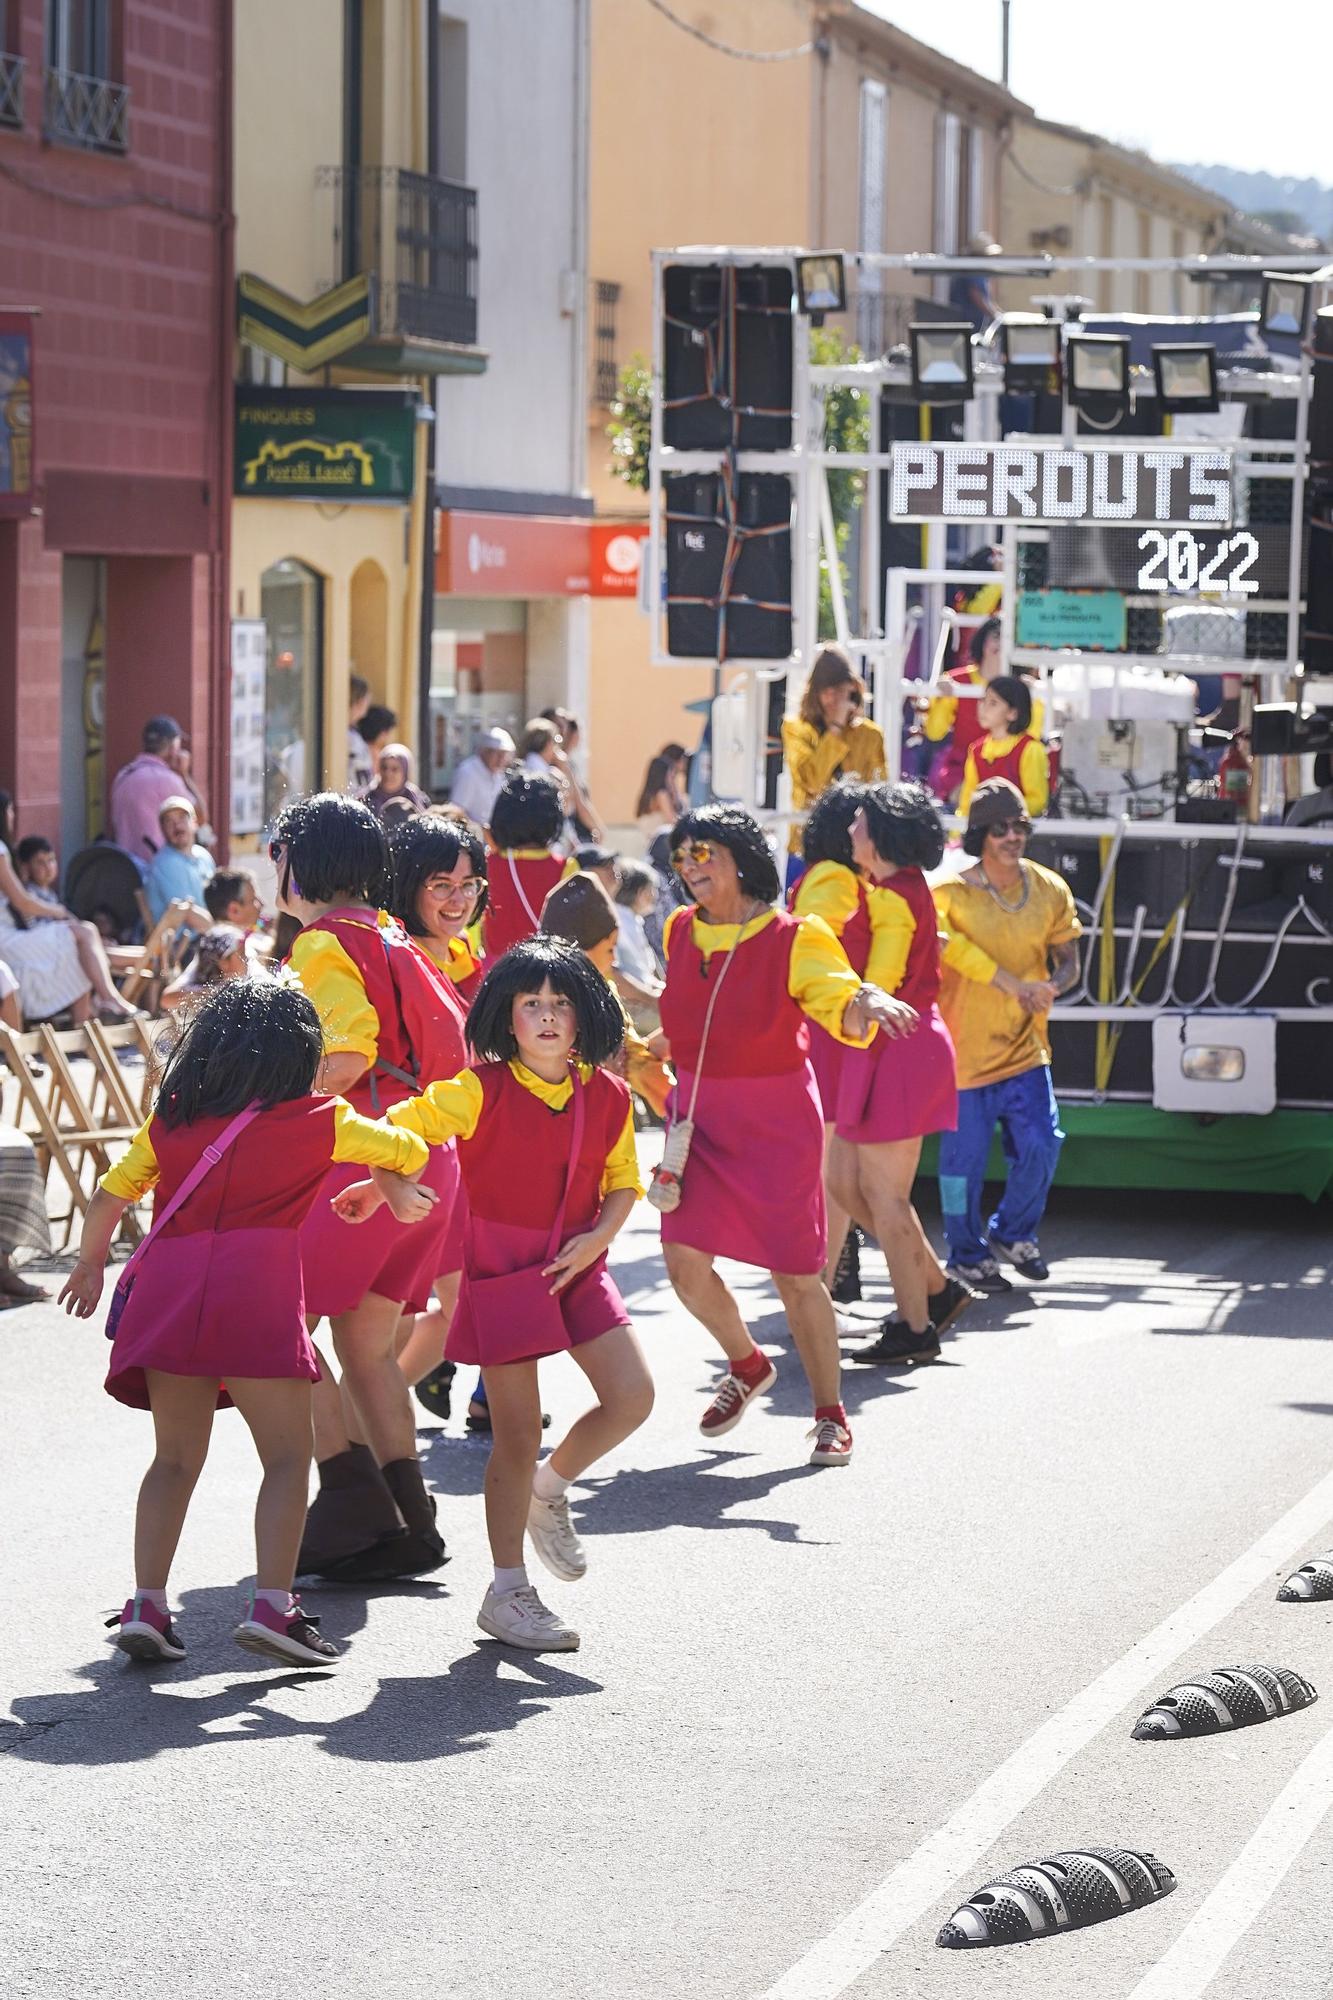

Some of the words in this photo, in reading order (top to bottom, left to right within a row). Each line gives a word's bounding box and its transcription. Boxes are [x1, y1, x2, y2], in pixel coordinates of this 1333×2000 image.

[240, 408, 315, 425] FINQUES
[892, 447, 1231, 521] PERDUTS
[1137, 530, 1260, 592] 2022
